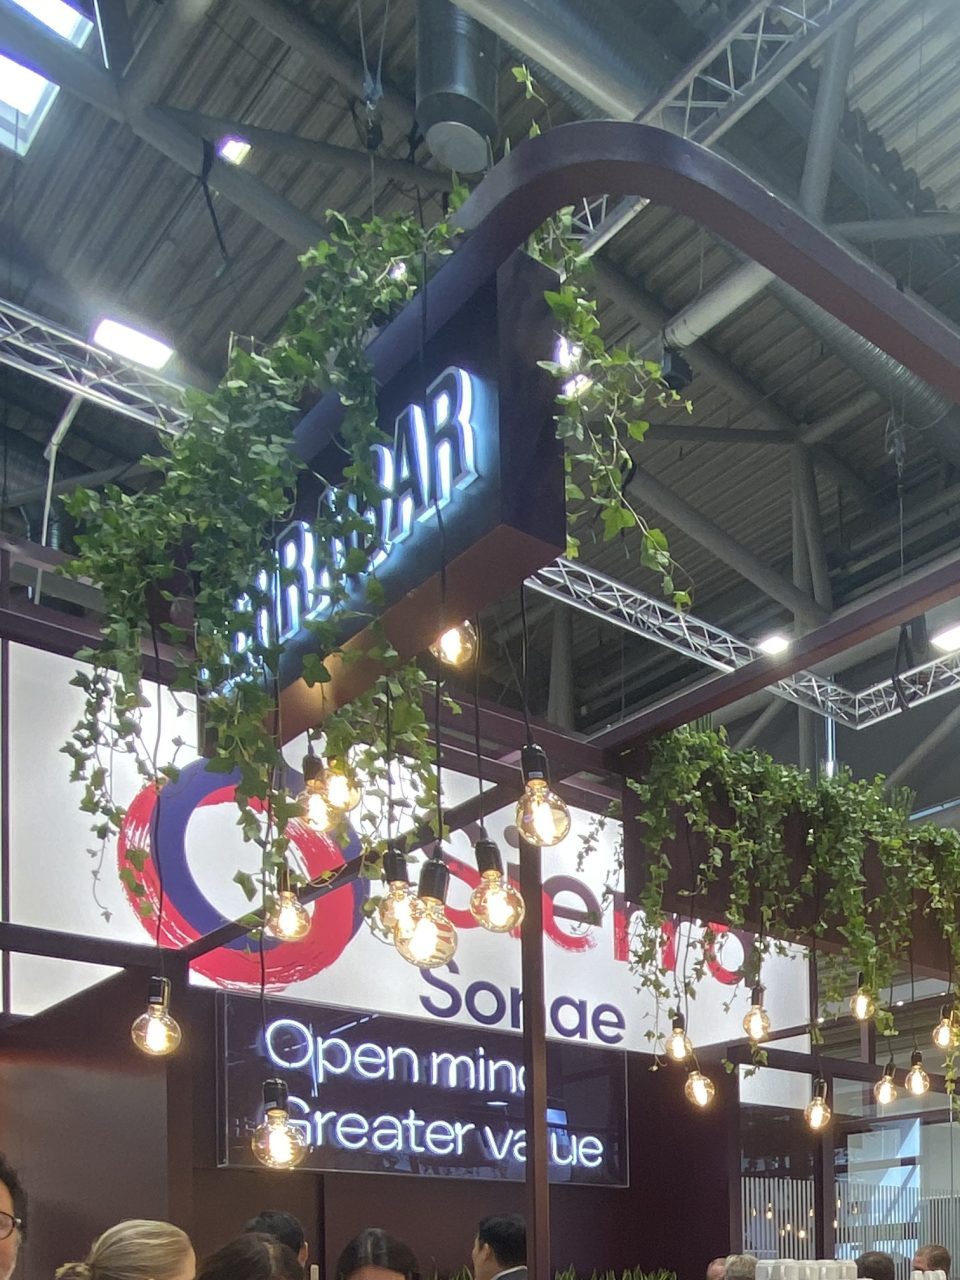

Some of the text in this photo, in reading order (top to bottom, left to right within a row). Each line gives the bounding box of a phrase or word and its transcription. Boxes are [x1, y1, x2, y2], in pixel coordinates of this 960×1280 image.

[264, 1018, 526, 1096] Open min
[484, 1126, 604, 1168] vaue
